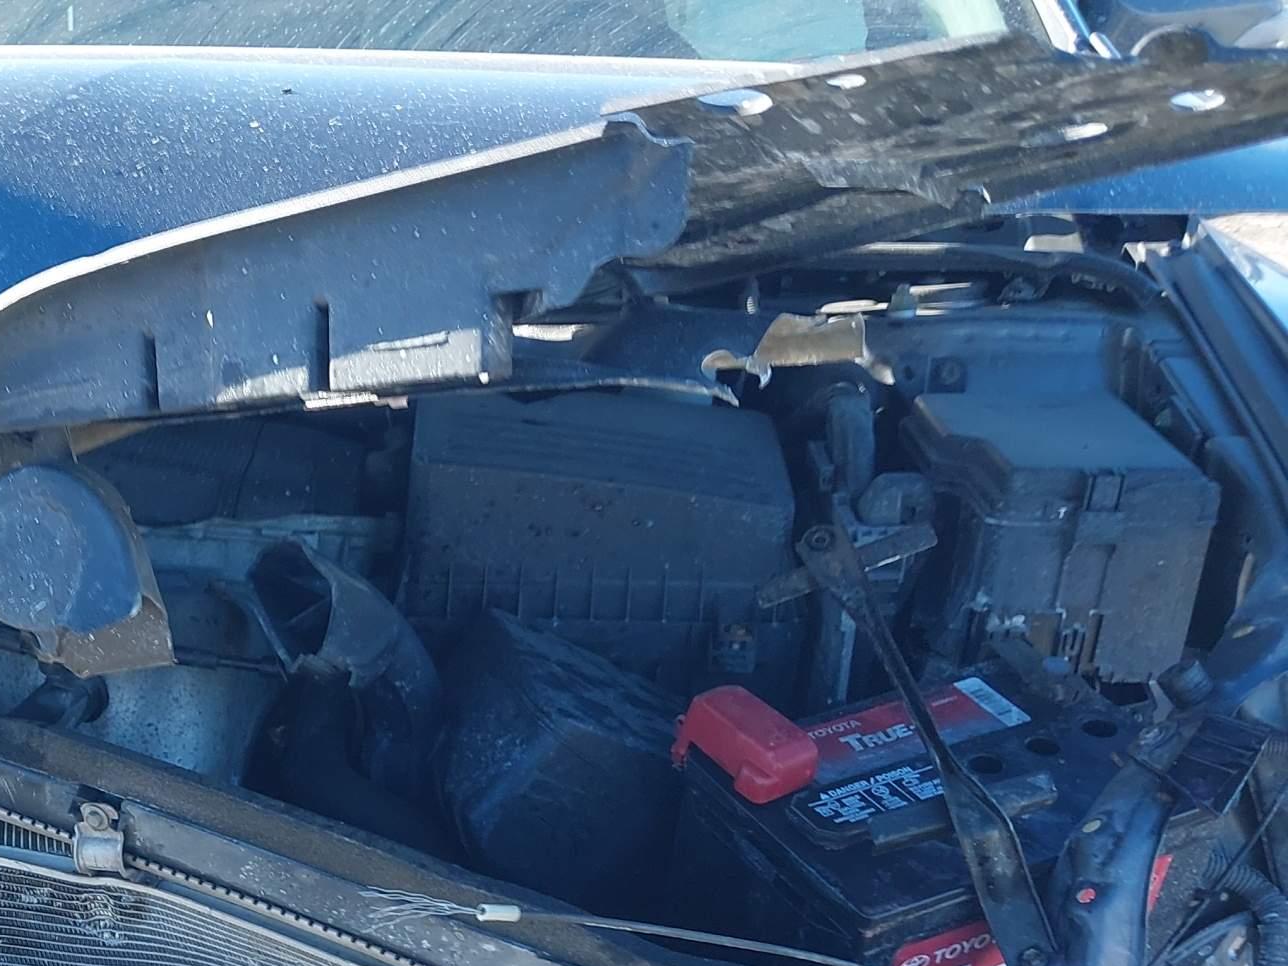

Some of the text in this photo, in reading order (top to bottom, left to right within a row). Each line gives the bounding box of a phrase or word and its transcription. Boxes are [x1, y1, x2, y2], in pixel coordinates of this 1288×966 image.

[807, 719, 862, 740] TOYOTA
[839, 723, 915, 751] TRUE
[828, 780, 870, 797] DANGER
[875, 766, 913, 781] POISON
[933, 933, 996, 964] TOYO
